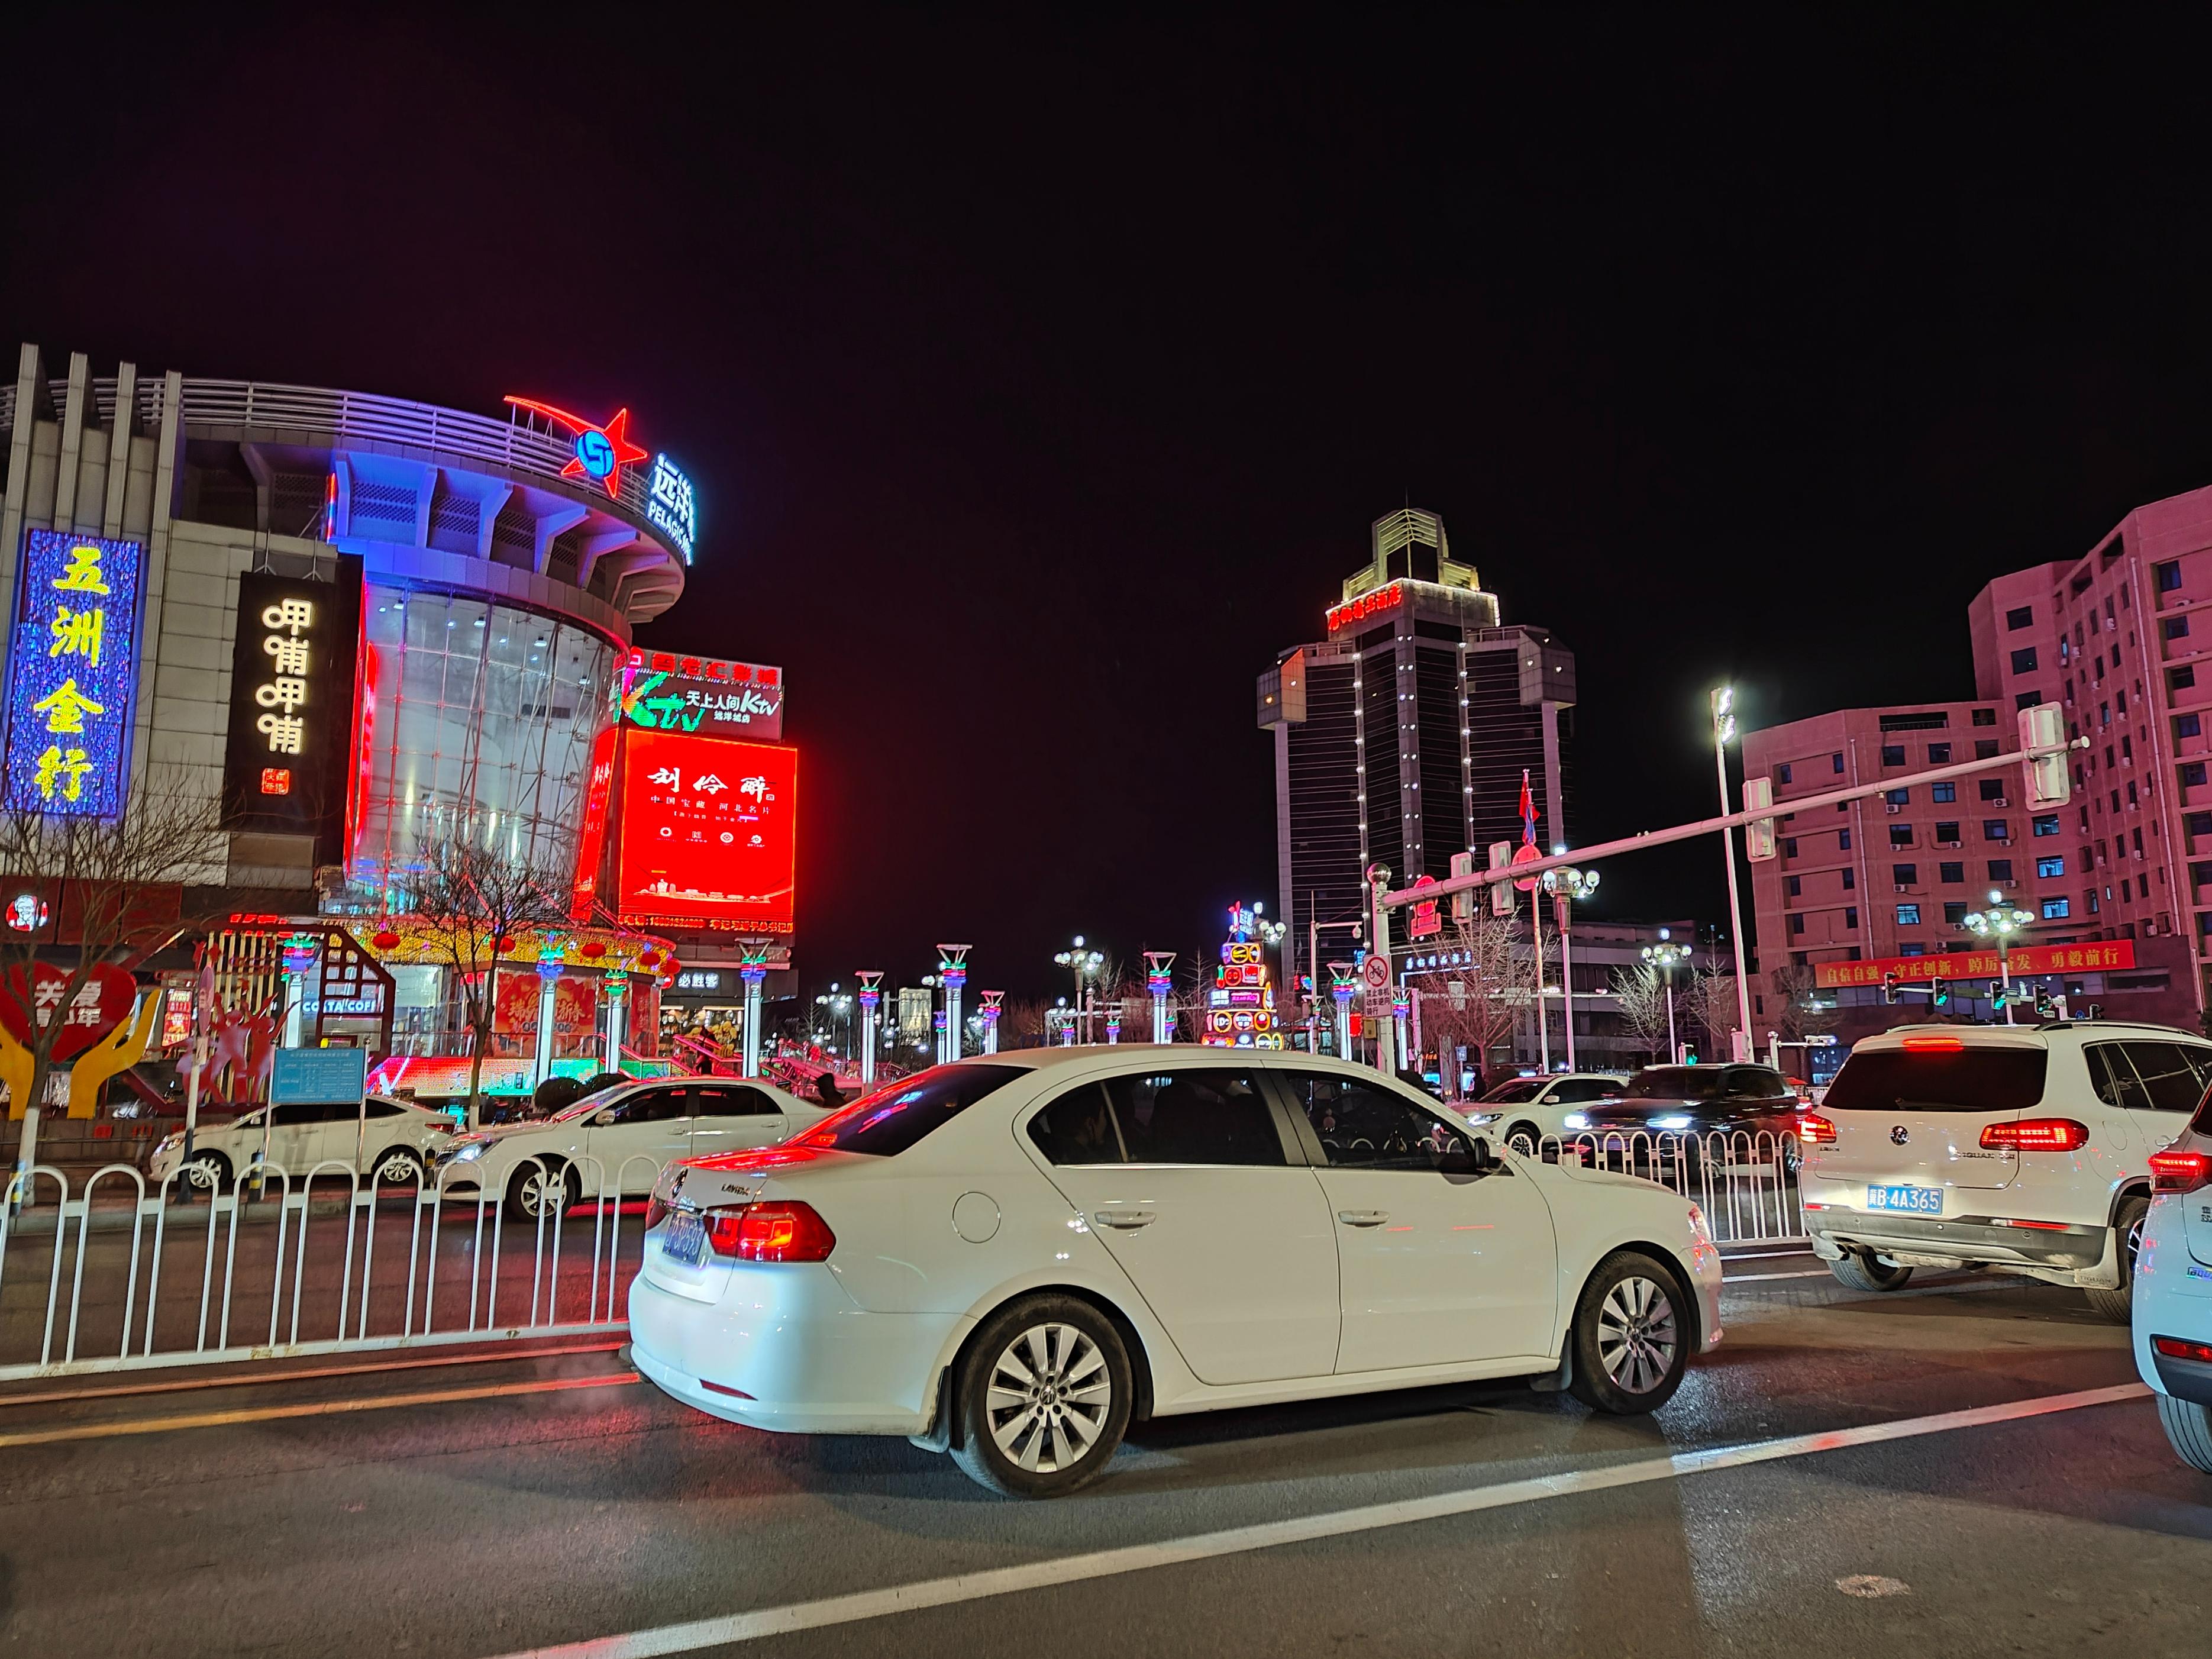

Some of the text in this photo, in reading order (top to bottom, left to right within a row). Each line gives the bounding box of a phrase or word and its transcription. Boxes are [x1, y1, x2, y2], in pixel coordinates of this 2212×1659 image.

[647, 499, 684, 545] PELAGIC
[34, 547, 109, 802] 五洲金行
[255, 598, 312, 755] 呷哺呷哺
[651, 652, 778, 685] 百老汇影城
[685, 689, 740, 712] 天上人间
[647, 767, 771, 803] 刘伶醉
[651, 795, 771, 815] 中国宝藏 河北名片
[678, 972, 719, 989] 必胜客
[34, 979, 102, 1007] 关爱
[1366, 987, 1390, 998] 禁止非机
[1366, 996, 1390, 1006] 动车逆向
[28, 1008, 102, 1028] 青年
[1366, 1006, 1378, 1016] 骑行
[721, 1183, 750, 1196] LAVIDA
